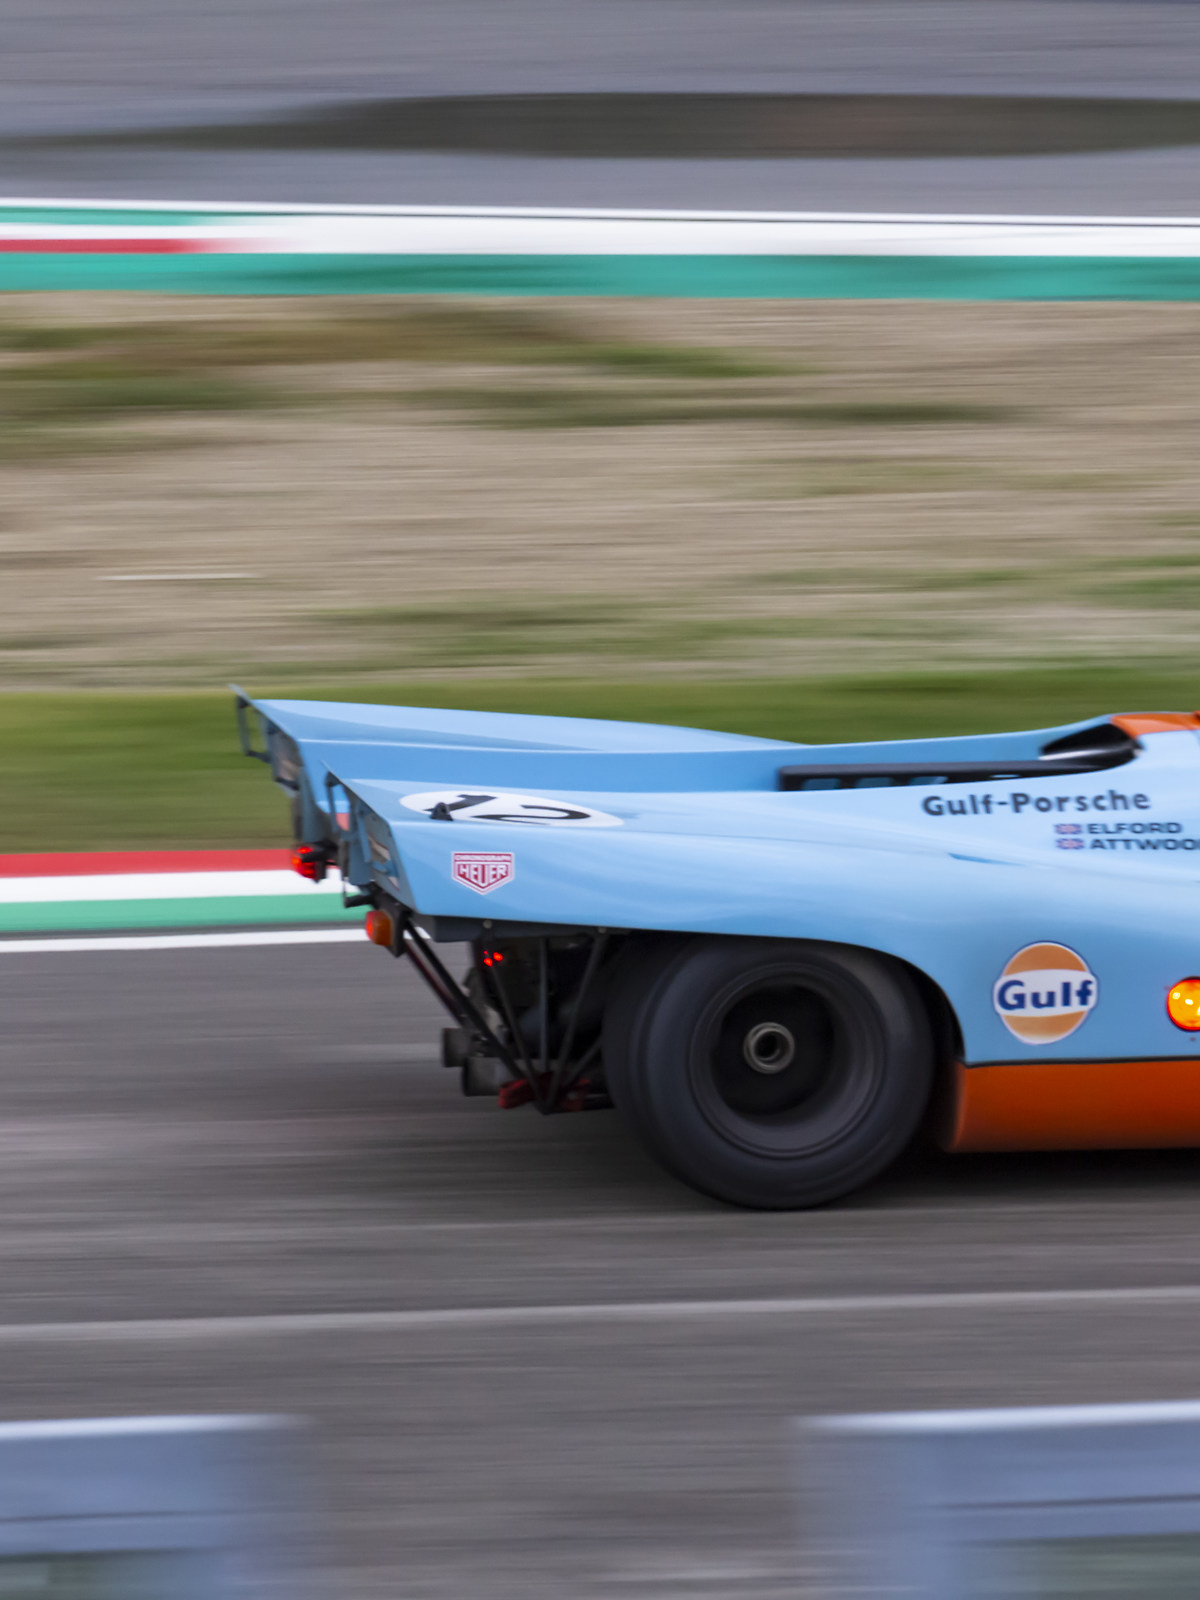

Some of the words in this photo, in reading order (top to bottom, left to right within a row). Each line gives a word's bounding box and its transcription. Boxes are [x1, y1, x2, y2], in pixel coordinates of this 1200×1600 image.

[922, 790, 1150, 816] Gulf-Porsche
[1087, 822, 1182, 835] ELFORD
[458, 863, 508, 885] HEUER
[997, 979, 1093, 1011] Gulf
